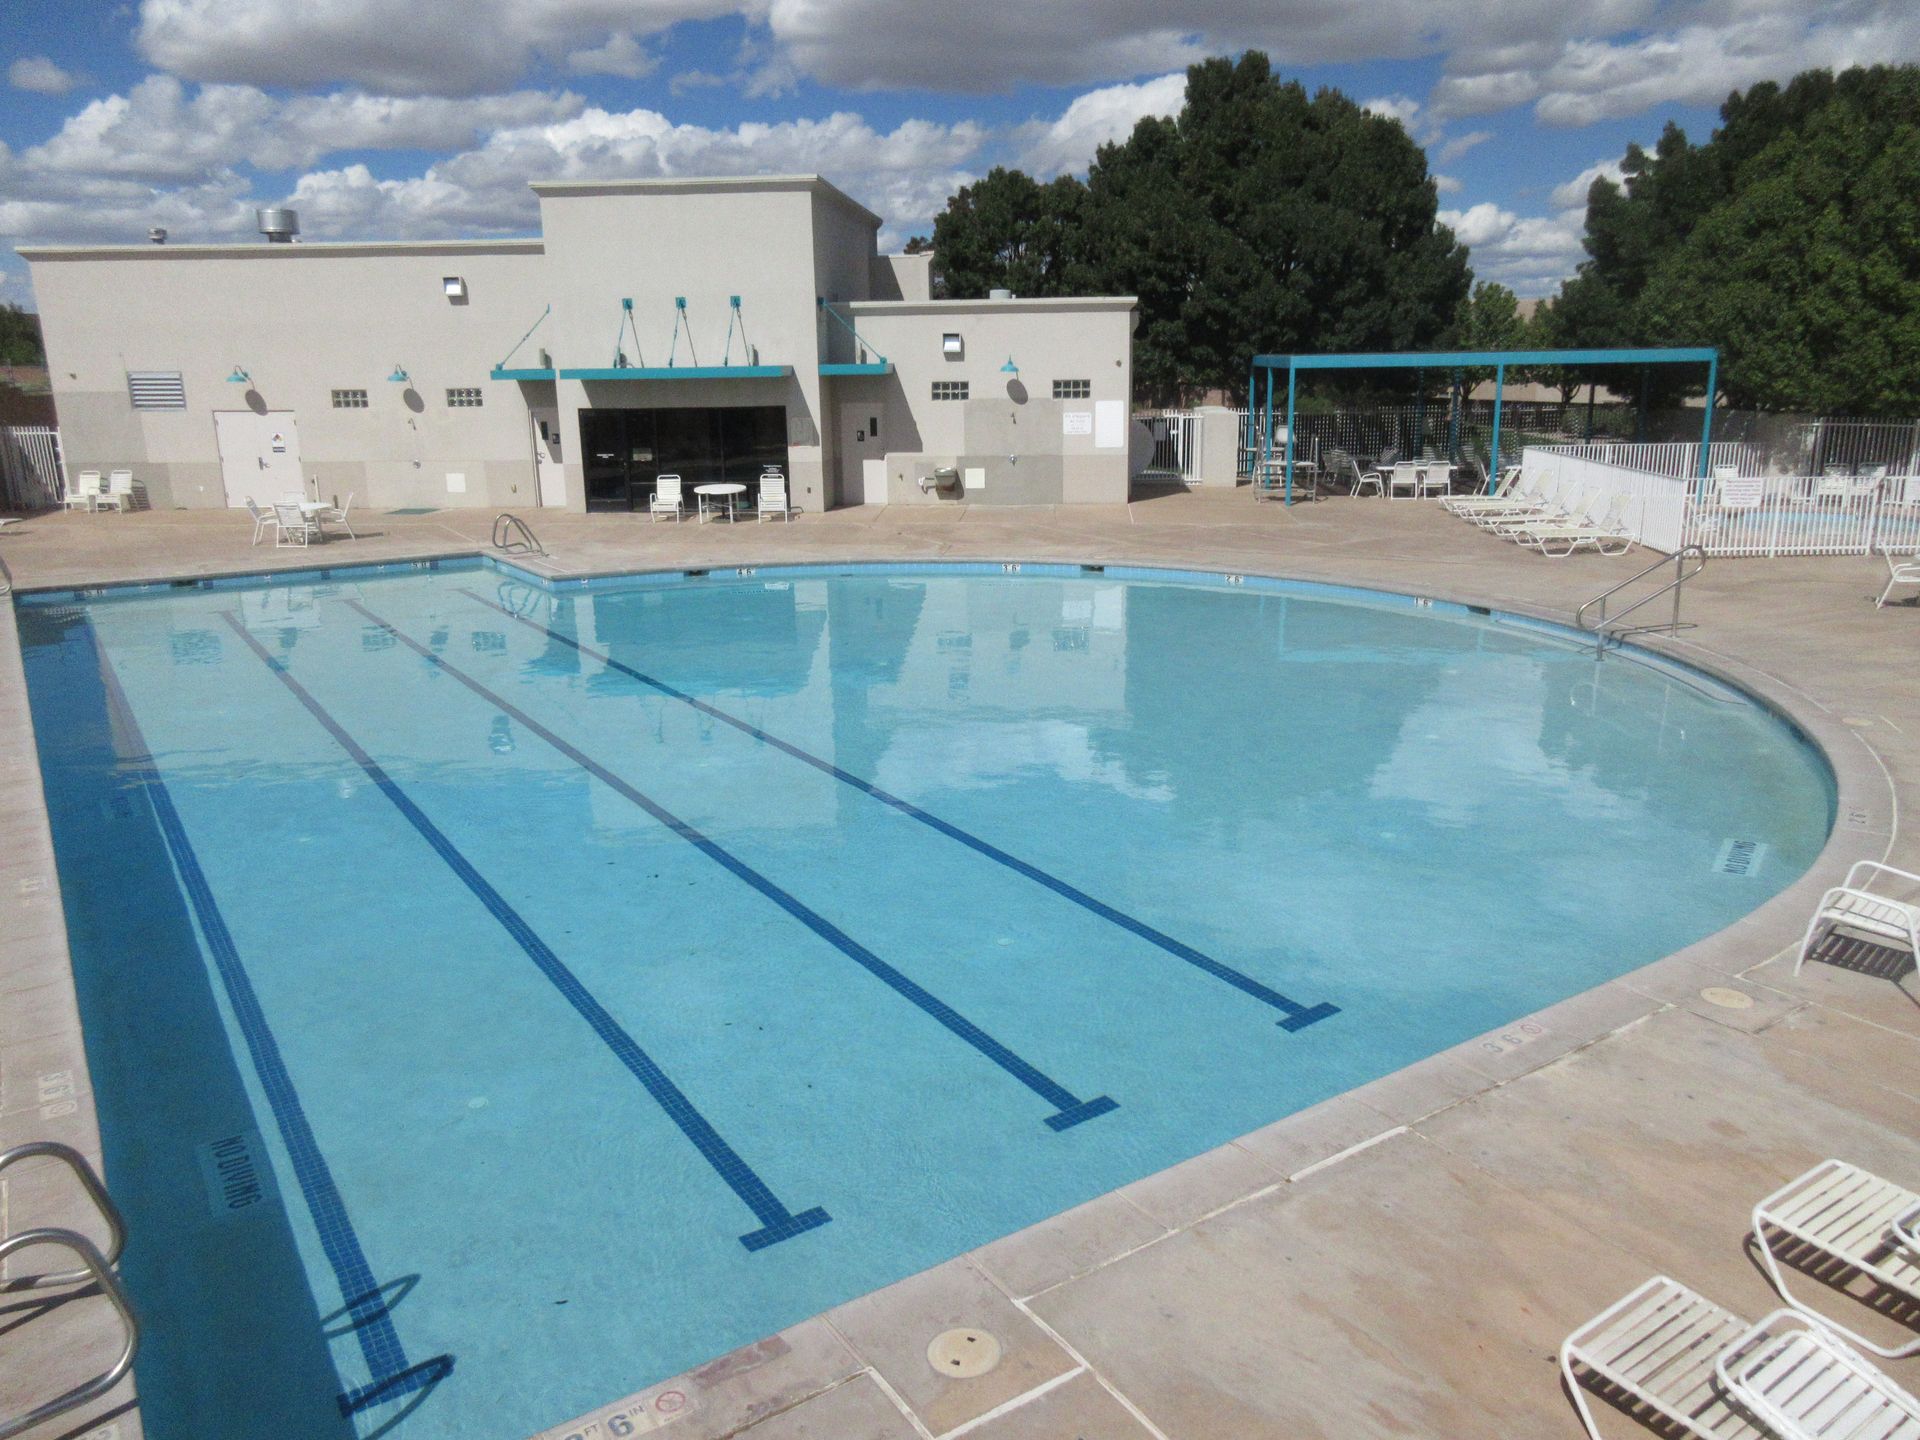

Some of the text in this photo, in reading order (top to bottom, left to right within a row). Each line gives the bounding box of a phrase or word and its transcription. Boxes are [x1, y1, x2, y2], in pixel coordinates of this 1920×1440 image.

[1722, 840, 1757, 875] NO DIVING
[211, 1135, 262, 1209] NO DIVING
[584, 1423, 599, 1437] FT
[607, 1414, 635, 1437] 6
[629, 1405, 645, 1417] IN
